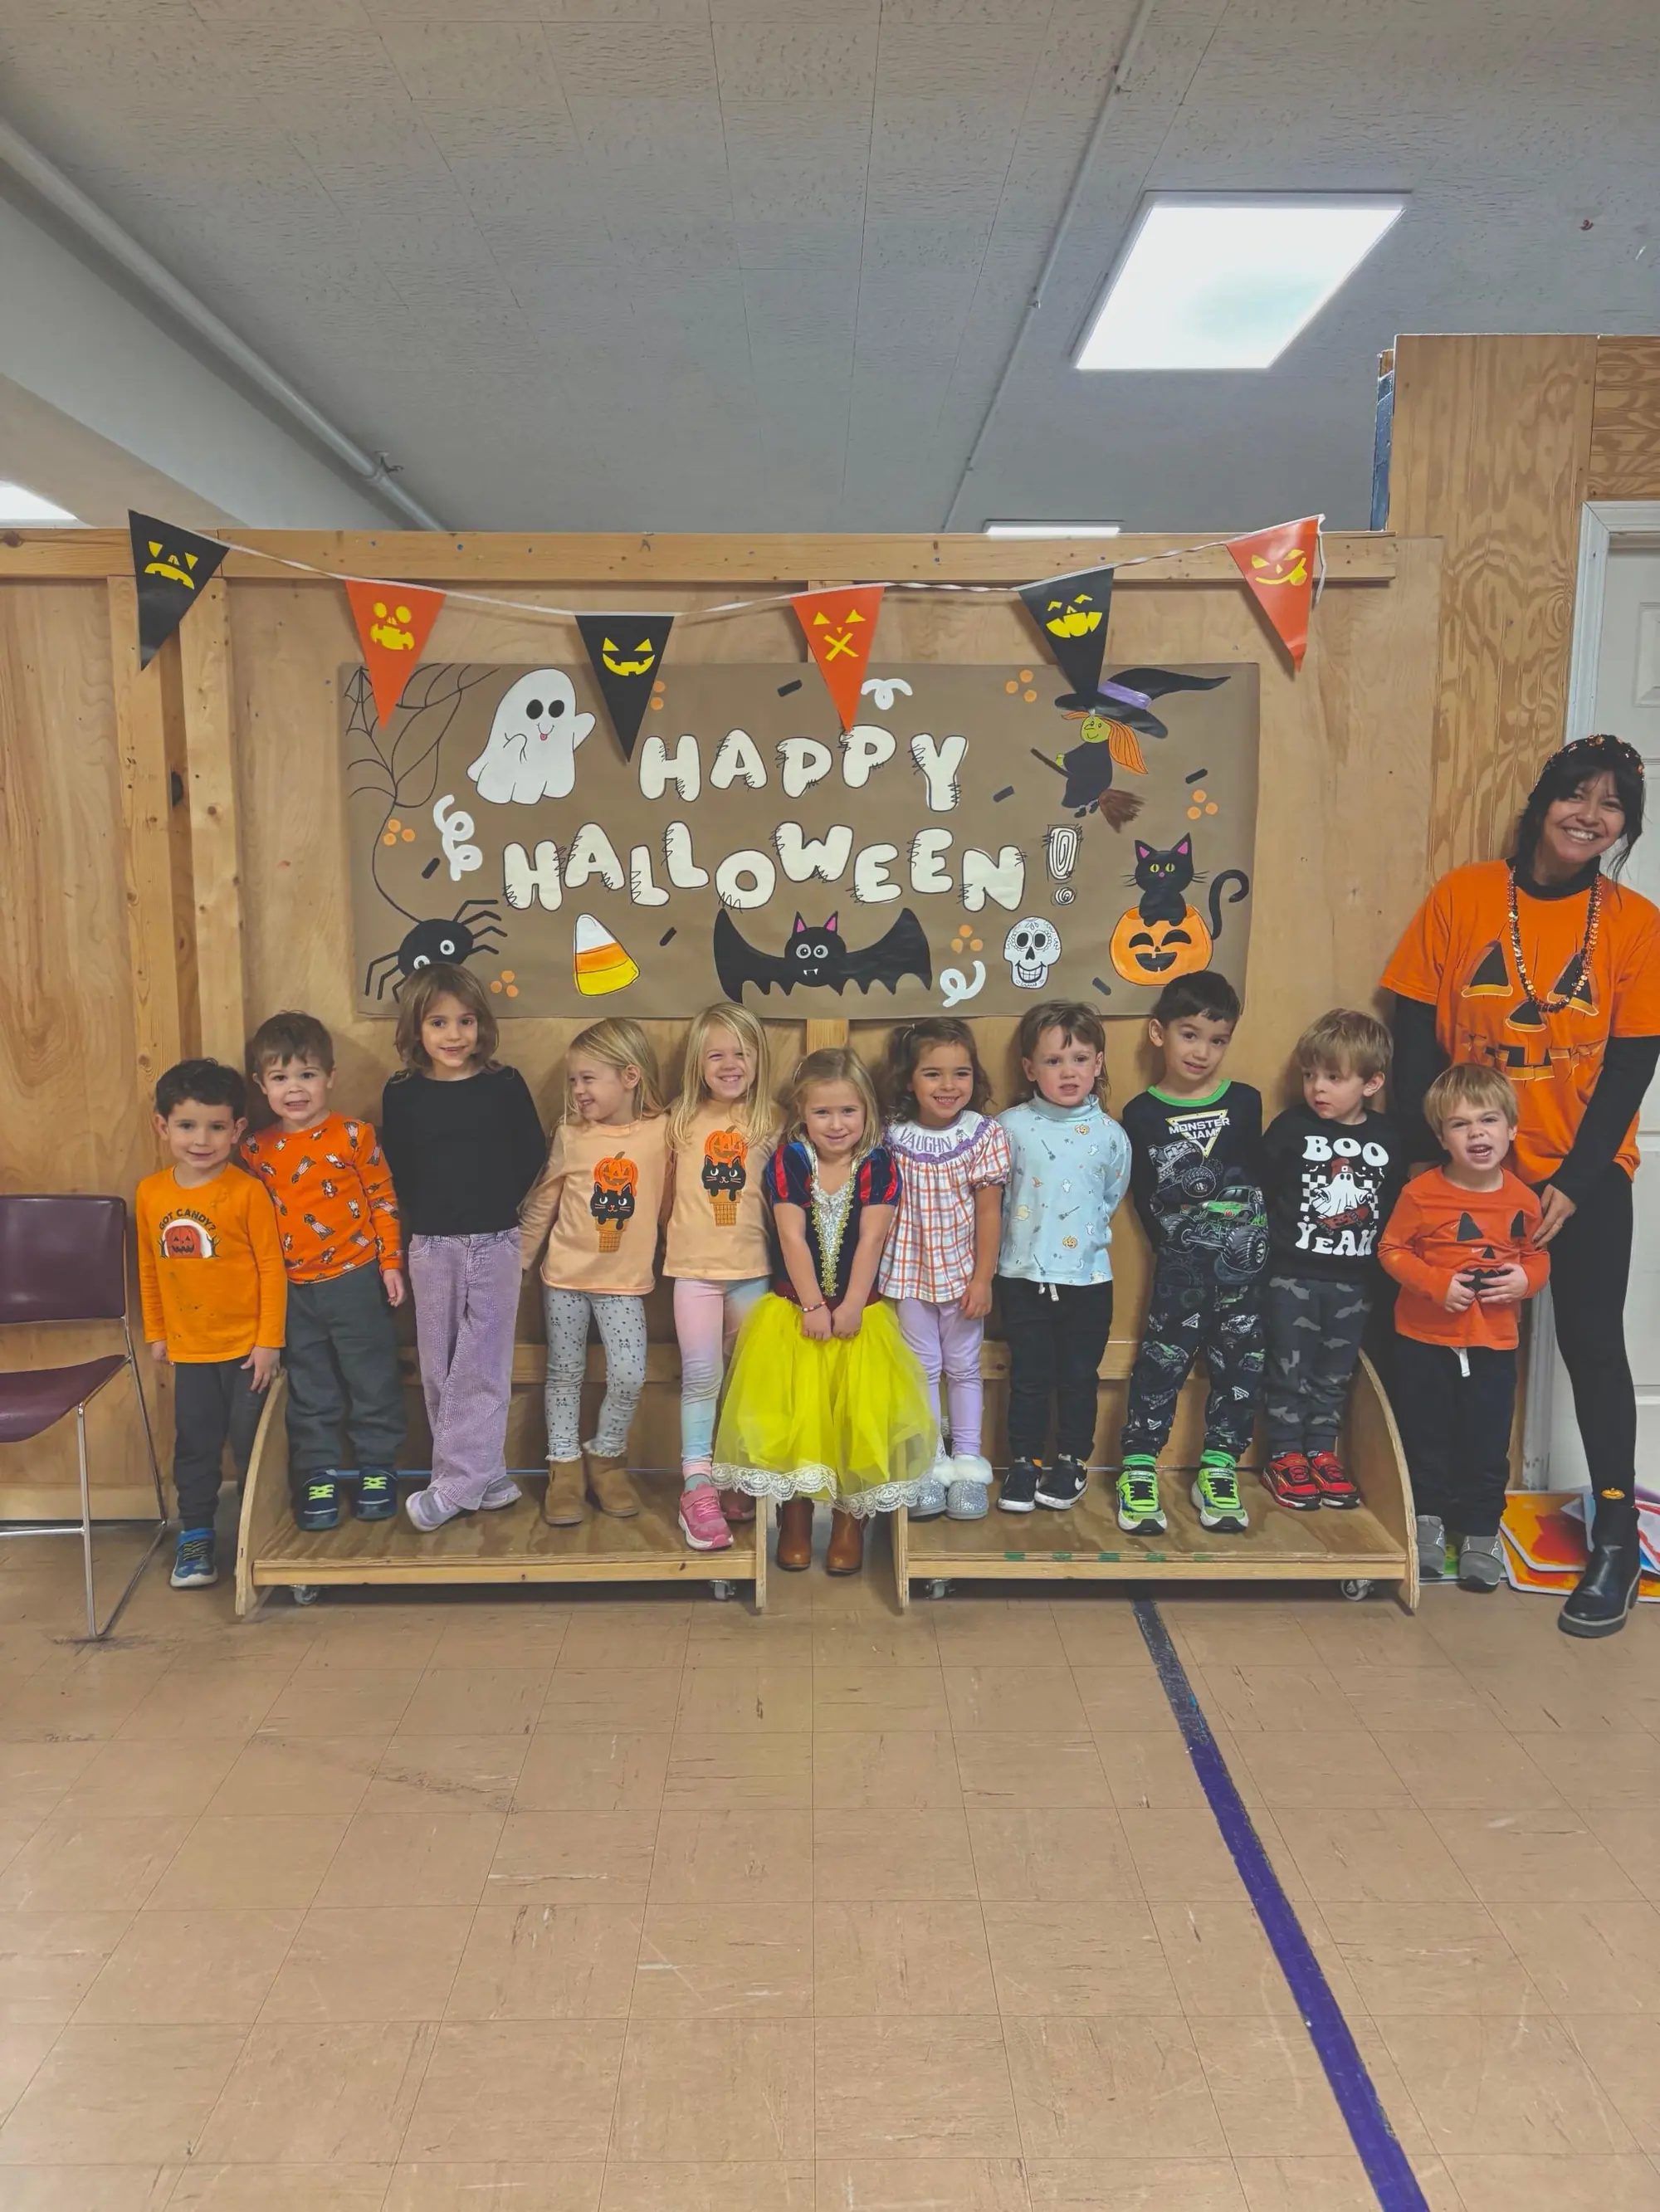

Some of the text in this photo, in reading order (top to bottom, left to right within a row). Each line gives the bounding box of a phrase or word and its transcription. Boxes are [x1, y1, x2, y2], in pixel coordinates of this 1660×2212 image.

[638, 725, 969, 813] HAPPY
[502, 822, 1083, 912] HALLOWEEN!
[1169, 1117, 1230, 1135] MONSTER
[1189, 1130, 1217, 1140] JAM
[1302, 1135, 1389, 1166] BOO
[159, 1209, 216, 1231] GOT CANDY?
[1295, 1222, 1377, 1256] YEAH
